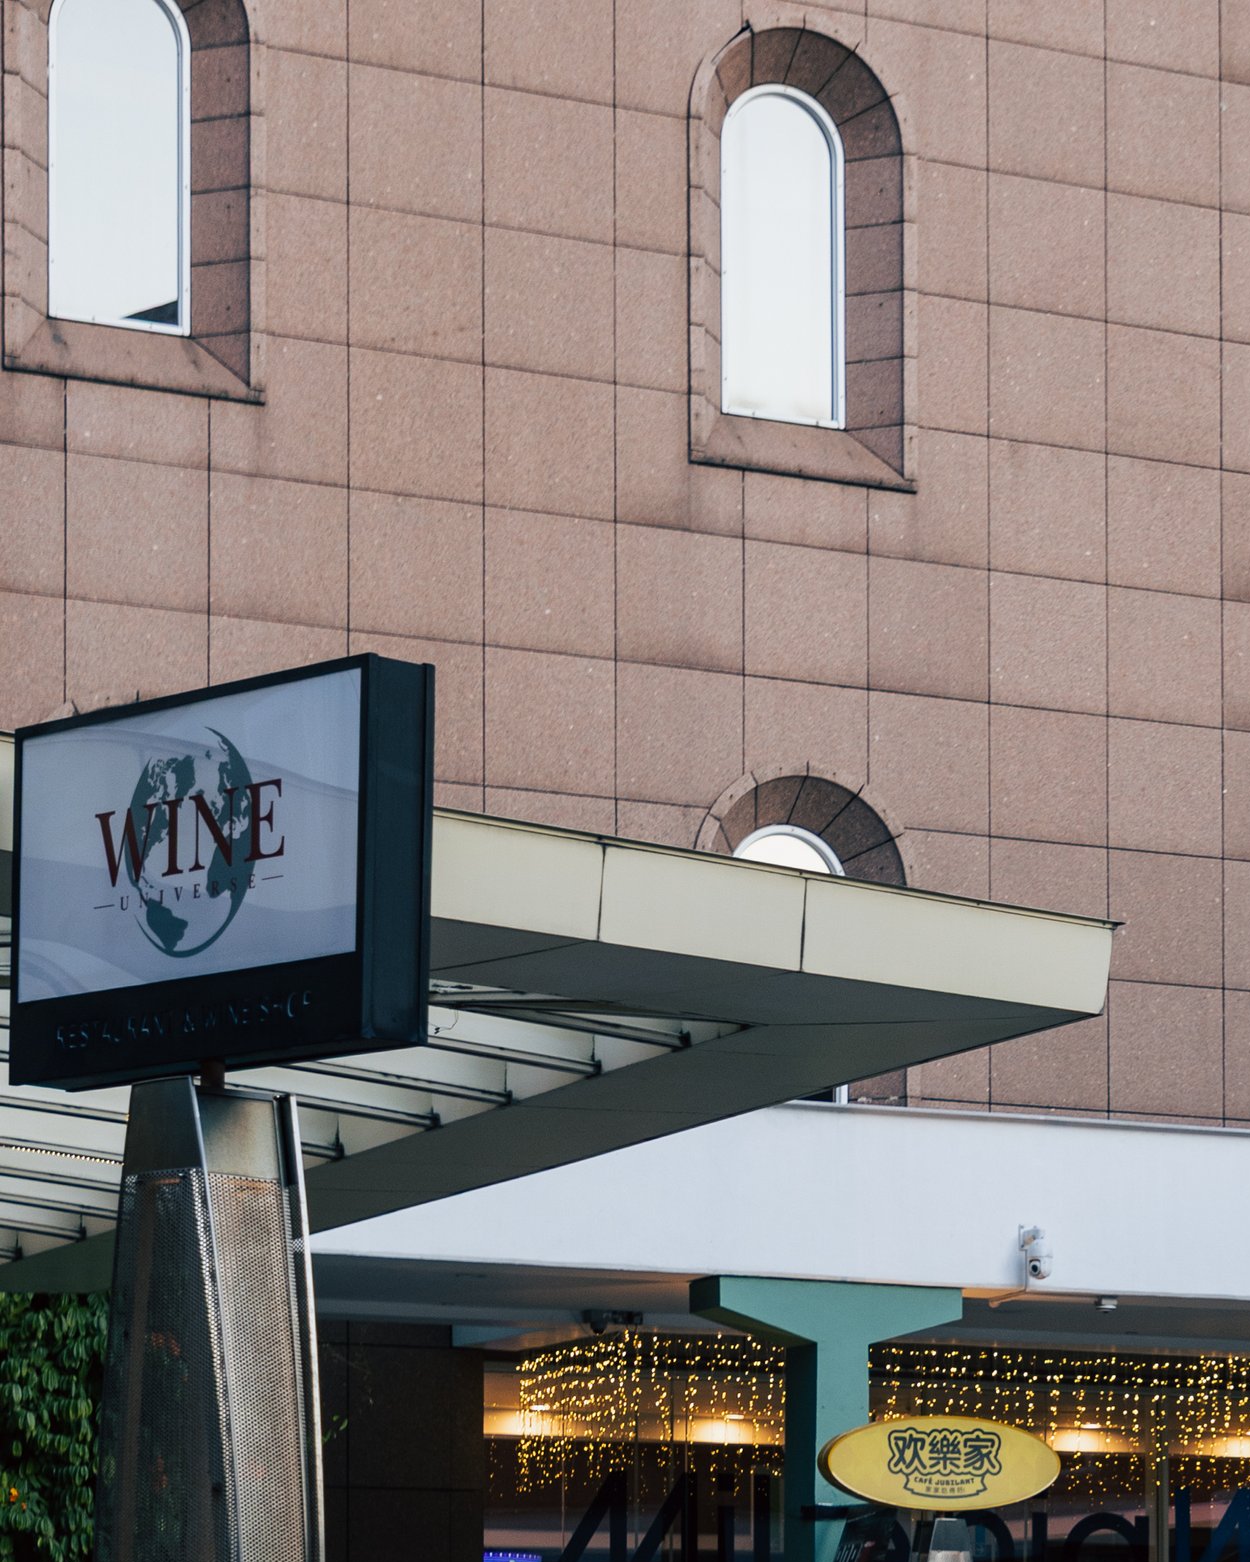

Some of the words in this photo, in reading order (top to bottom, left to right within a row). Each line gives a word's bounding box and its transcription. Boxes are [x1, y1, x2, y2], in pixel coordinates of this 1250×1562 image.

[95, 778, 285, 887] WINE
[120, 873, 256, 911] UNIVERSE
[893, 1434, 996, 1471] 欢樂家
[913, 1476, 933, 1486] CAFÉ
[934, 1477, 976, 1487] JUBILANT
